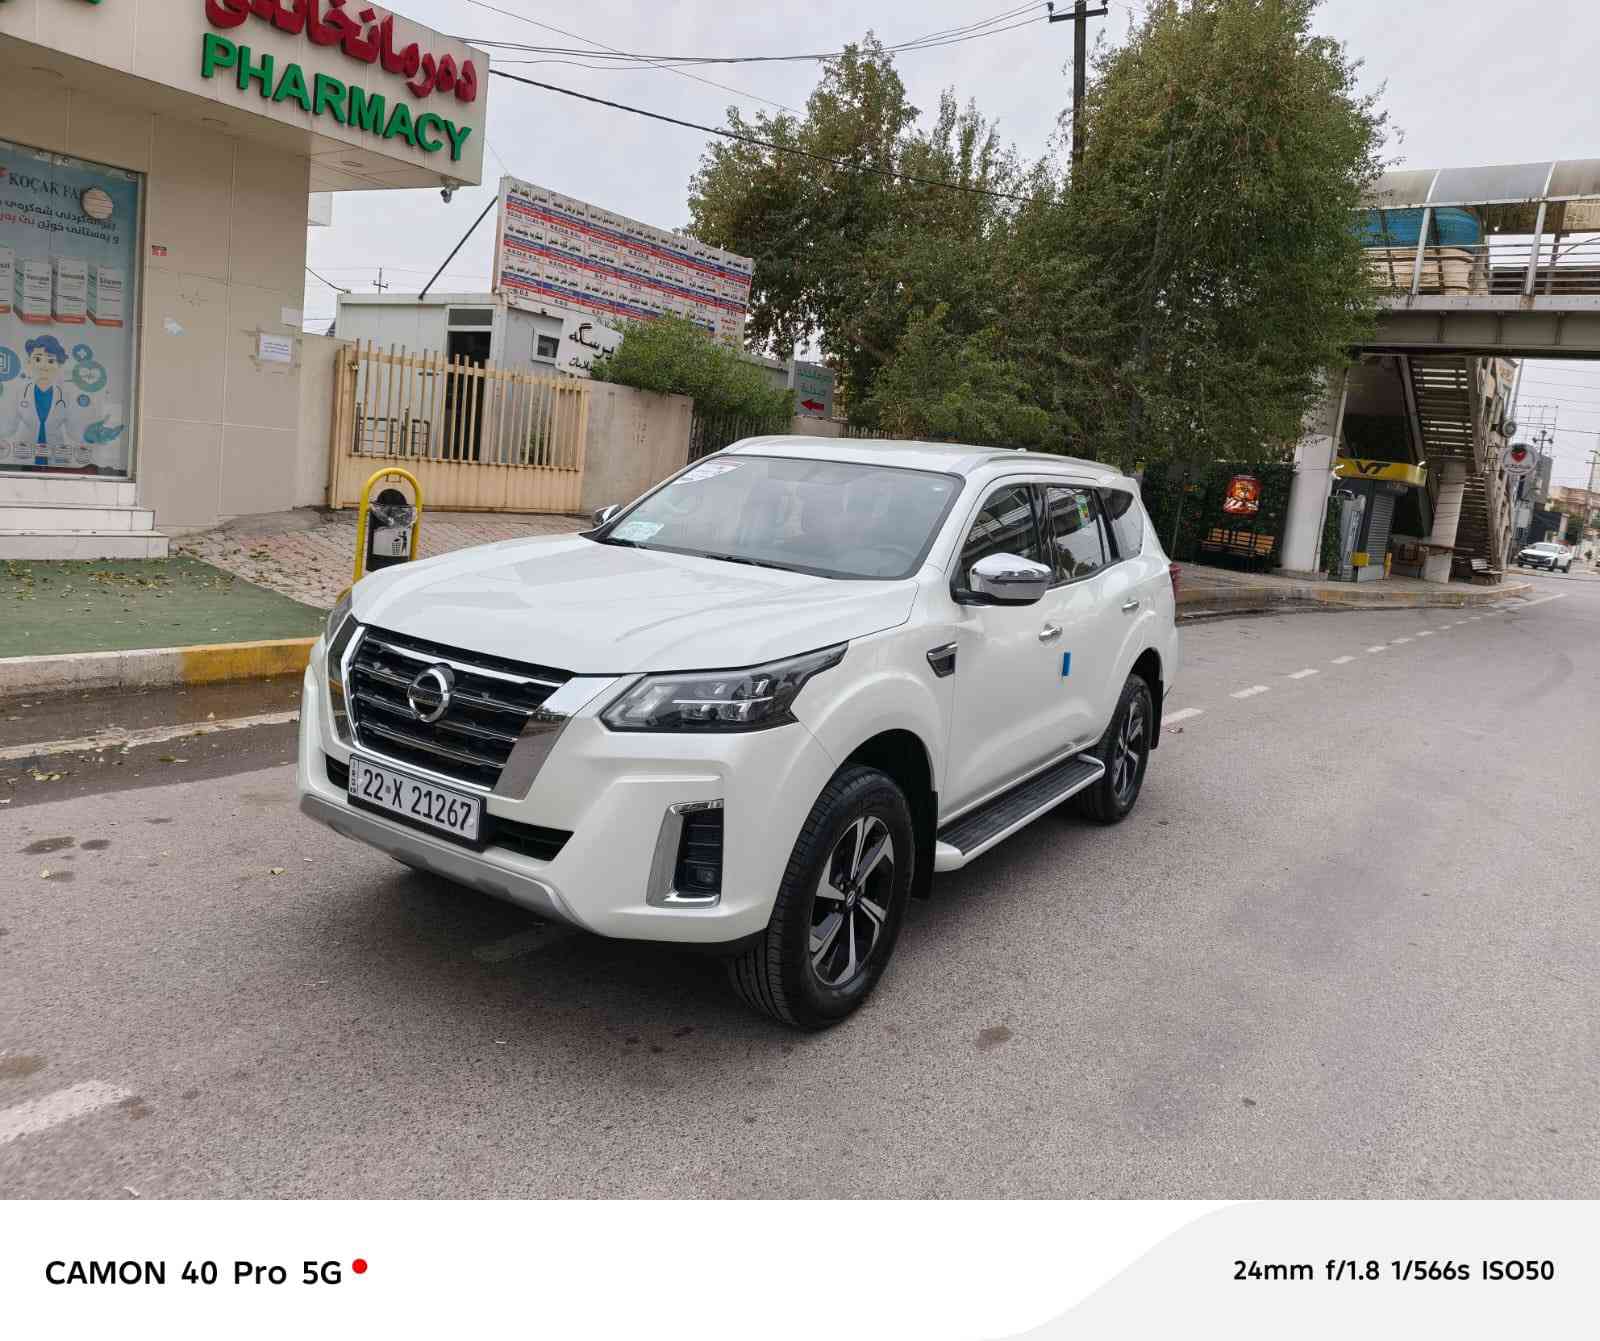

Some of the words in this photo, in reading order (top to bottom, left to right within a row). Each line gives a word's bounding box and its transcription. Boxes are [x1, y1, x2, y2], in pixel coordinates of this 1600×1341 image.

[202, 32, 471, 160] PHARMACY
[9, 172, 60, 197] KOÇAK
[364, 769, 384, 801] 22
[392, 778, 403, 809] X
[411, 786, 471, 831] 21267
